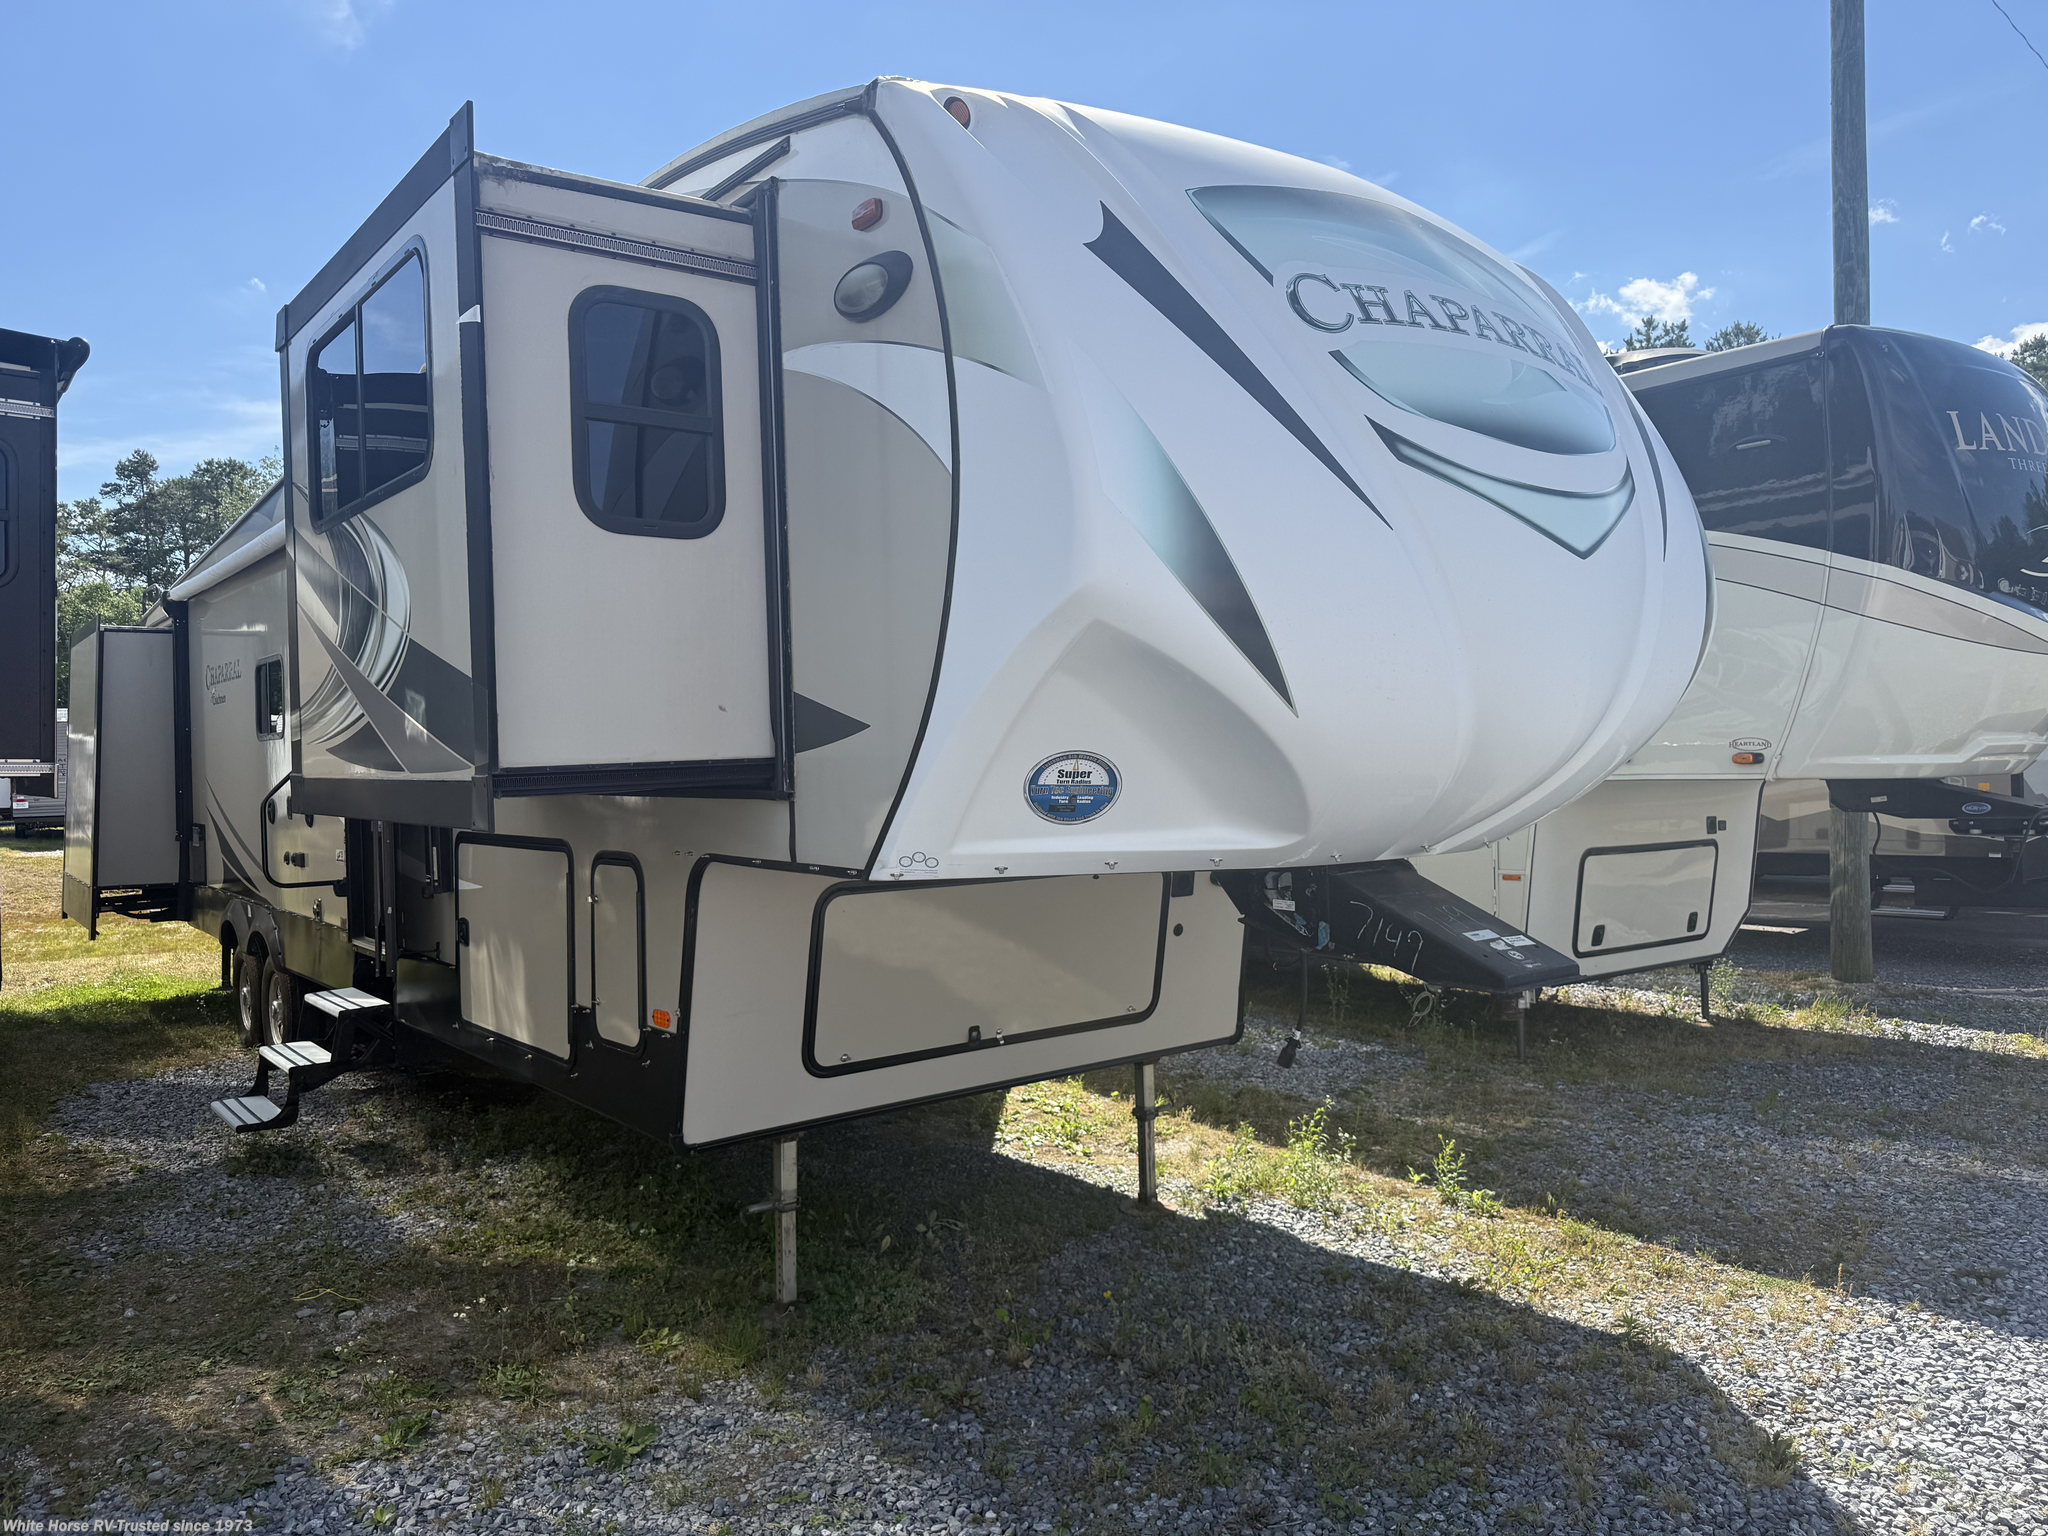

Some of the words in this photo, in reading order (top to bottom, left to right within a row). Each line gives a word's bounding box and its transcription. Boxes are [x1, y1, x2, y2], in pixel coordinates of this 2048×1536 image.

[1946, 410, 2048, 455] LAND
[205, 659, 242, 690] CHAPARRAL
[1057, 769, 1093, 780] Super
[1030, 785, 1049, 796] Turn
[1065, 785, 1114, 799] Engineering
